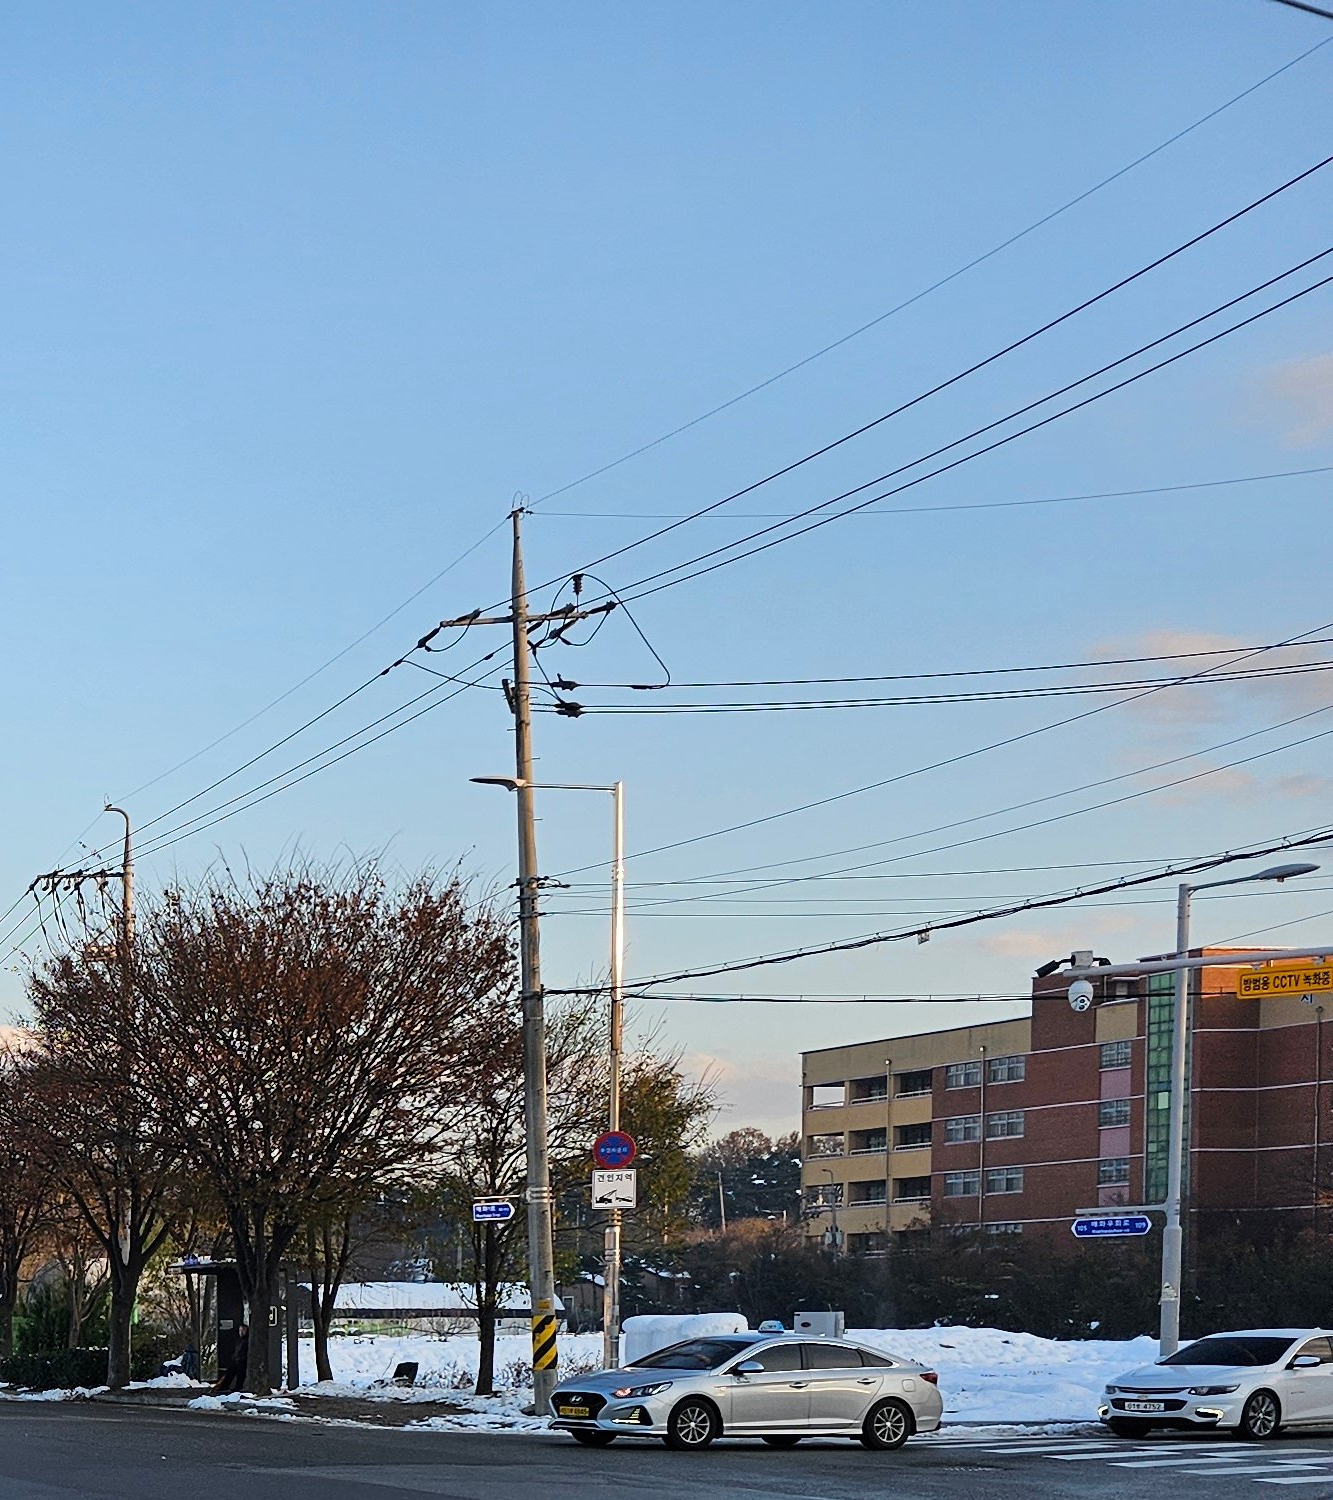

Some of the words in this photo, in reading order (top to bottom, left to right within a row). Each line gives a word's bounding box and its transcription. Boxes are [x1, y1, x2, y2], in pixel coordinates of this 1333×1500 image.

[1243, 976, 1270, 992] 방범용
[1273, 974, 1300, 989] CCTV
[1303, 971, 1330, 986] 녹화중
[597, 1173, 633, 1183] 견인지역
